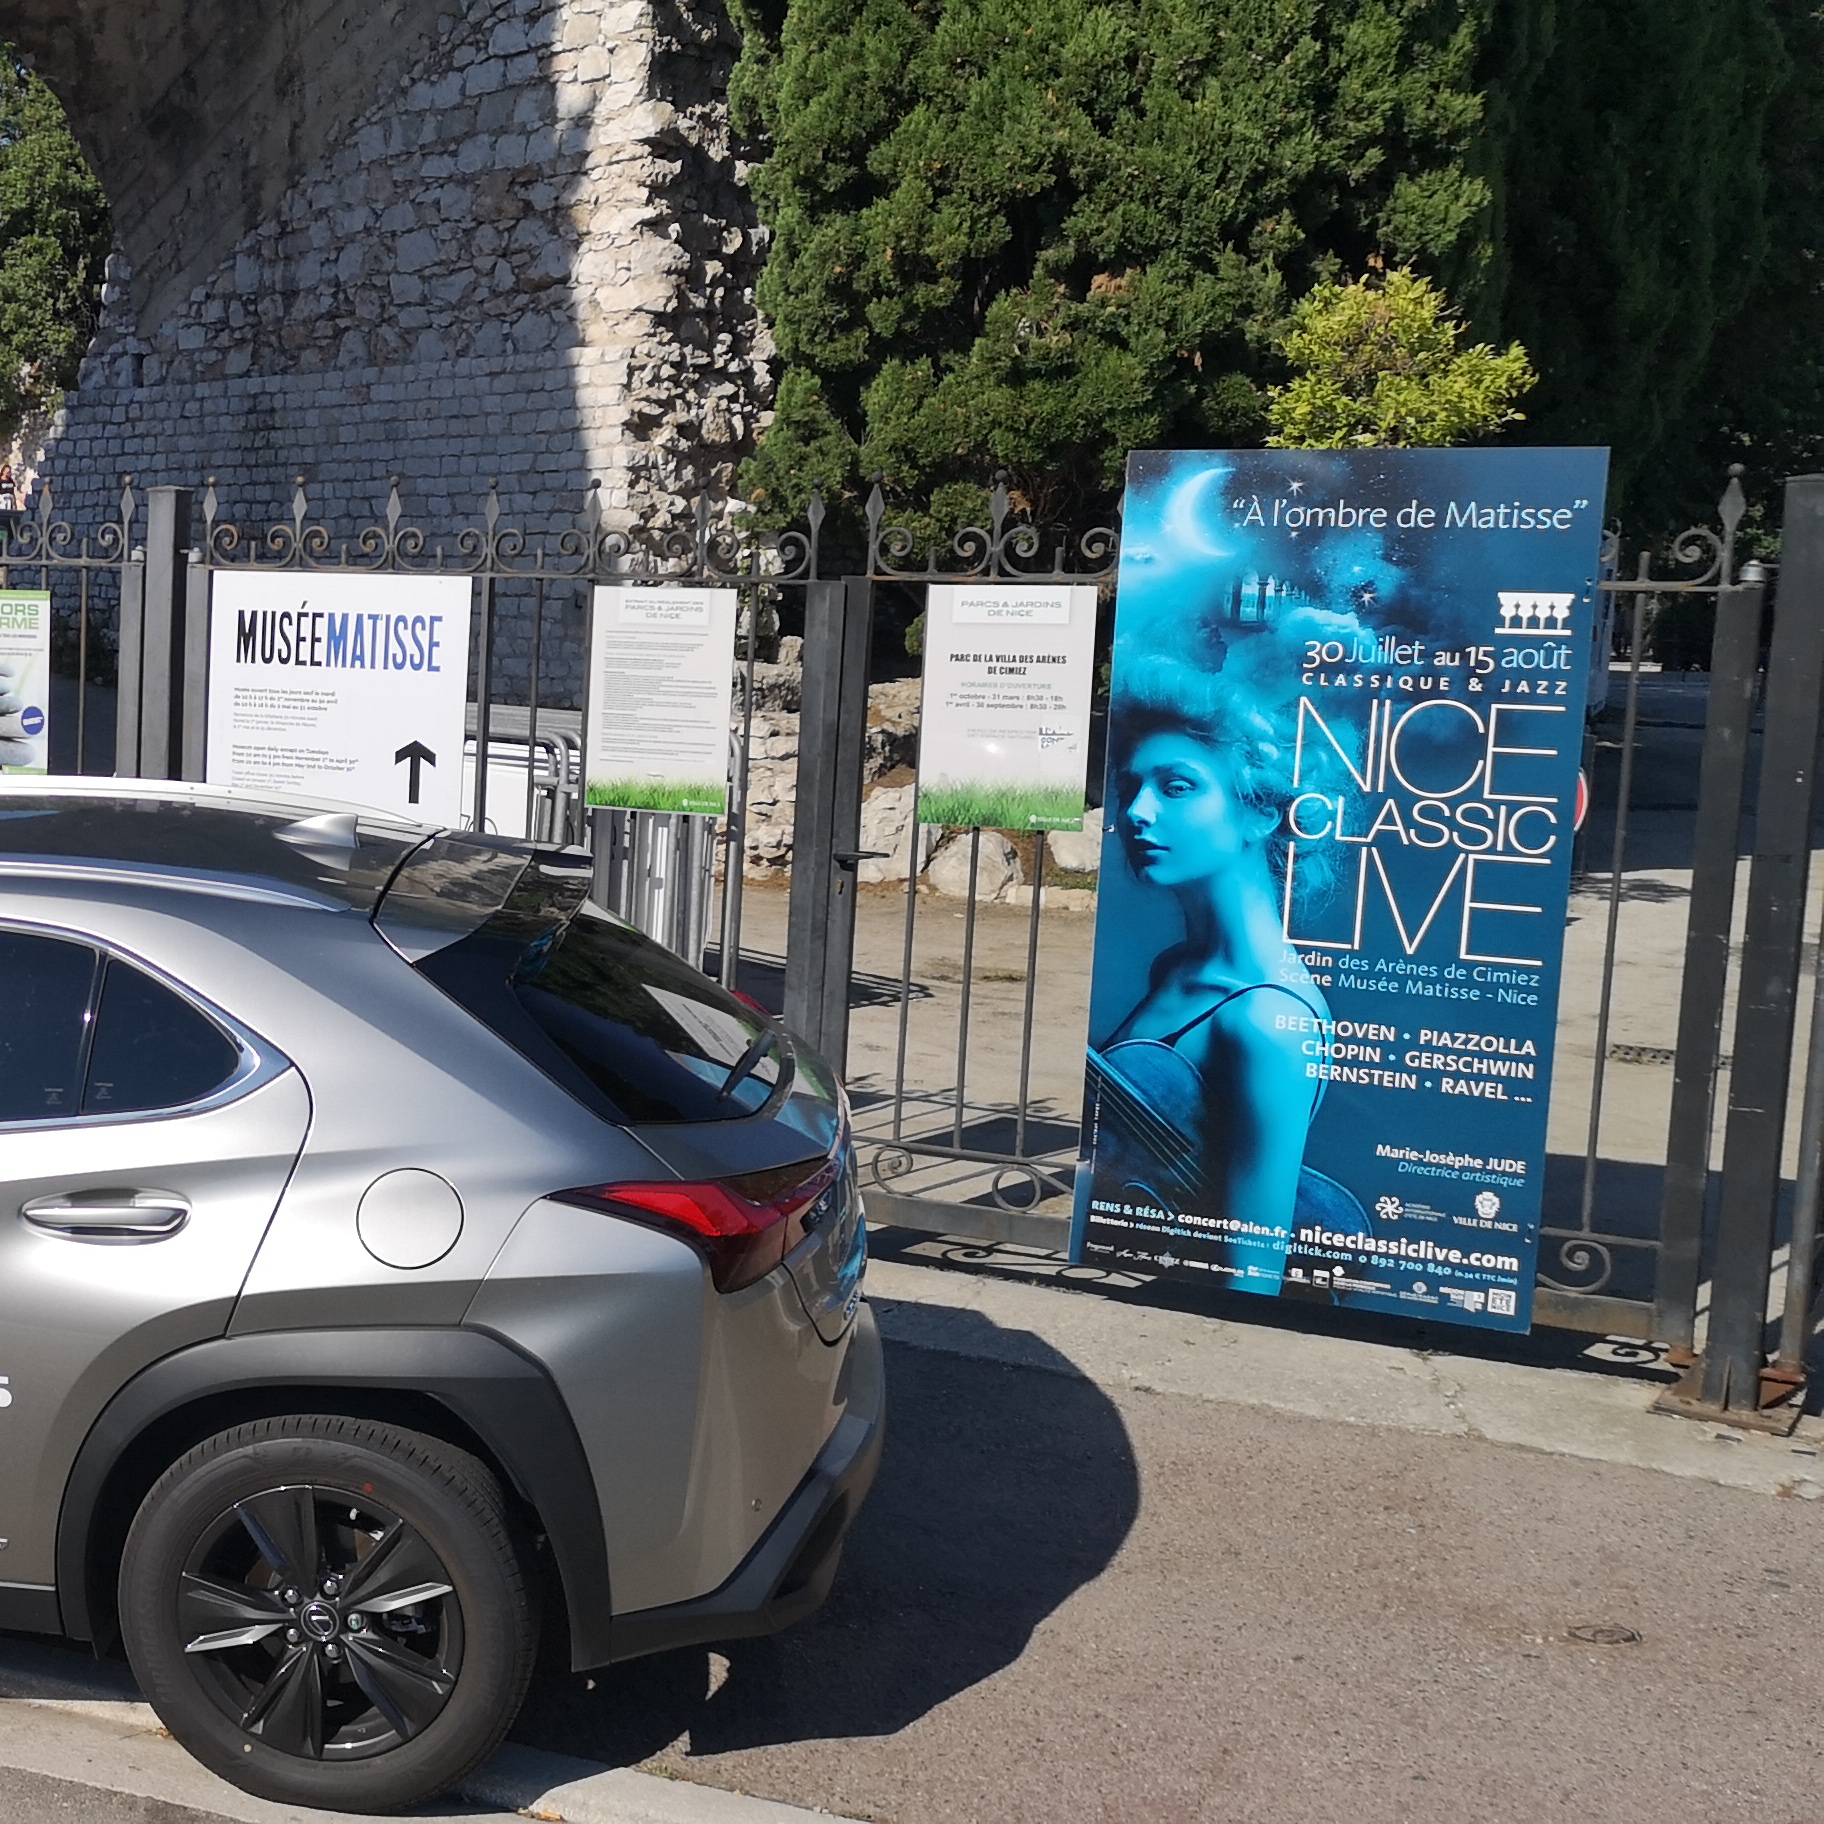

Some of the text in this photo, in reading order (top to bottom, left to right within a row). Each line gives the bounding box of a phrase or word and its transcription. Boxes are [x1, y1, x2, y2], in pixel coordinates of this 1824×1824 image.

[1396, 500, 1437, 528] de
[961, 600, 999, 609] PARCS
[1011, 600, 1062, 609] JARDINS
[987, 609, 1034, 617] DE NICE
[950, 653, 971, 662] PARC
[973, 654, 982, 662] DE
[984, 654, 994, 663] LA
[996, 654, 1017, 663] VILLA
[1019, 655, 1034, 664] DES
[988, 666, 1027, 675] DE CIMIEZ
[1302, 636, 1573, 674] 30 Juillet au 15 août
[1302, 672, 1569, 695] CLASSIQUE & JAZZ
[986, 702, 1024, 710] septembre
[1293, 696, 1566, 803] NICE
[1289, 793, 1558, 855] CLASSIC
[1283, 841, 1552, 967] LIVE
[1279, 950, 1540, 987] Jardin des Arènes de Cimiez
[1279, 968, 1332, 987] Scène
[1338, 972, 1399, 993] Musée
[1405, 979, 1480, 1001] Matisse
[1497, 988, 1539, 1006] Nice
[1274, 1015, 1537, 1056] BEETHOVEN PIAZZOLLA
[1301, 1040, 1535, 1080] CHOPIN GERSCHWIN
[1305, 1062, 1417, 1090] BERNSTEIN
[1441, 1077, 1508, 1100] RAVEL
[1376, 1144, 1526, 1174] Marie-Josèphe JUDE
[1397, 1161, 1526, 1188] Directrice artistique
[1091, 1200, 1121, 1214] RENS
[1123, 1204, 1133, 1216] &
[1136, 1205, 1165, 1220] RÉSA
[1299, 1224, 1520, 1272] niceclassiclive.com
[1452, 1215, 1519, 1233] VILLE DE NICE
[1272, 1240, 1353, 1263] digitick.com
[1371, 1254, 1395, 1268] 892
[1398, 1260, 1423, 1271] 700
[1426, 1262, 1452, 1276] 840
